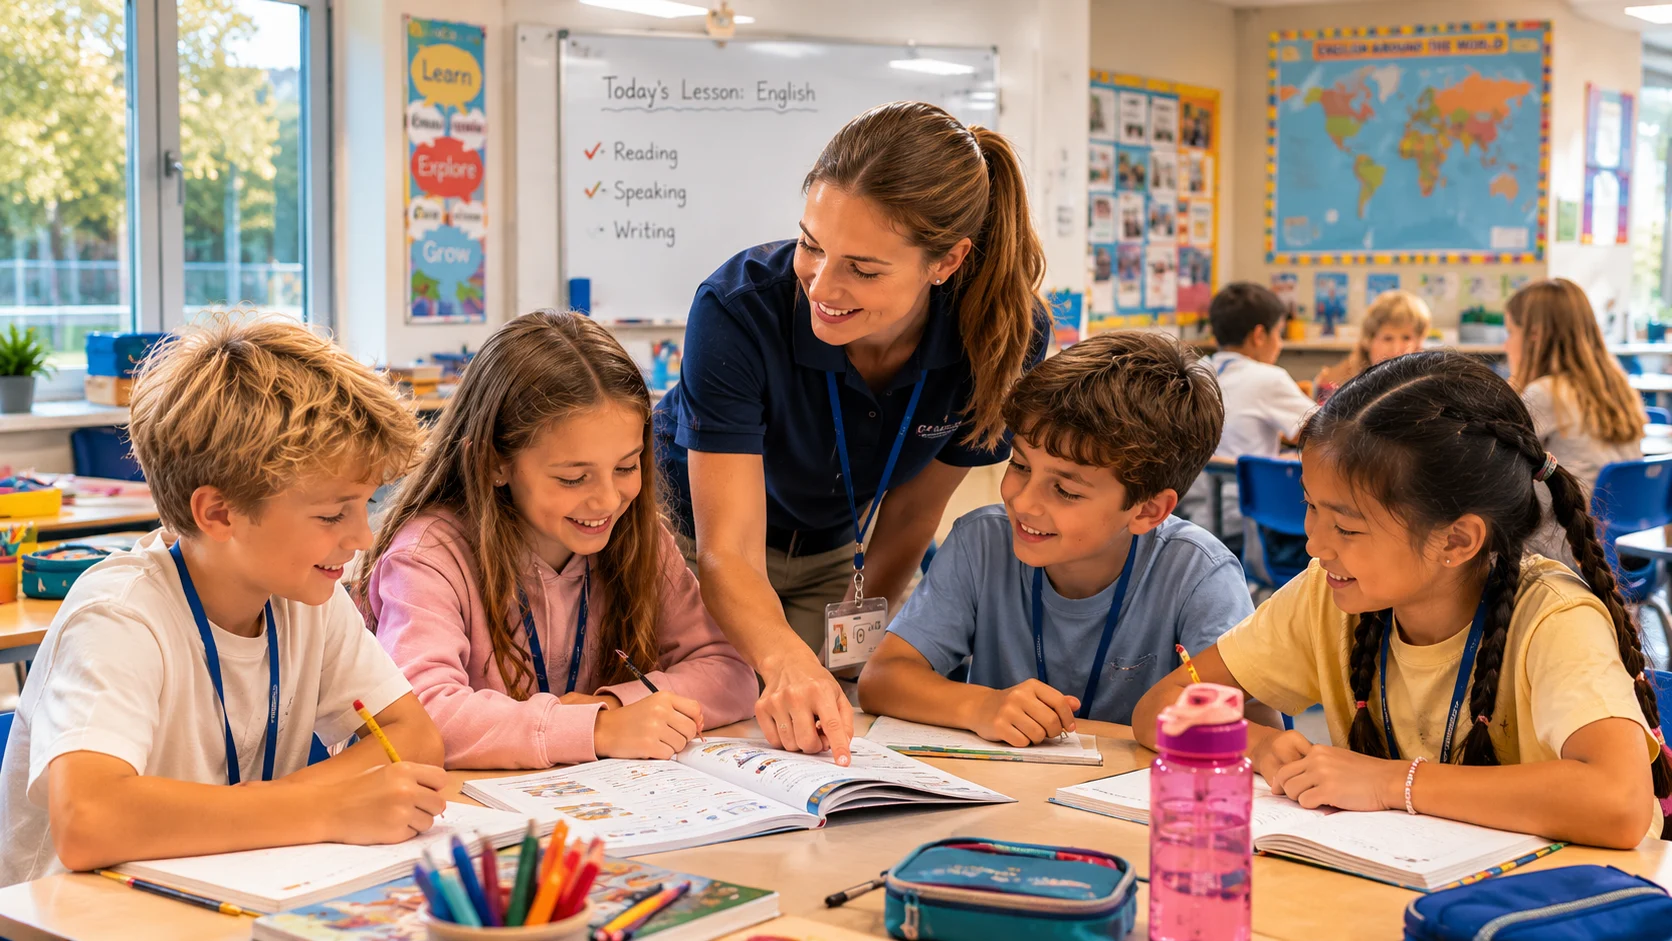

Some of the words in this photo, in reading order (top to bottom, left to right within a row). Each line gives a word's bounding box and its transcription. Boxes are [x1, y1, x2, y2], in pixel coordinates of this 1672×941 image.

[422, 59, 472, 87] Learn
[602, 75, 669, 108] Today's
[681, 79, 745, 101] Lesson:
[757, 80, 816, 108] English
[418, 155, 477, 183] Explore
[614, 141, 678, 169] Reading
[614, 180, 687, 208] Speaking
[614, 221, 676, 248] Writing
[422, 242, 471, 264] Grow
